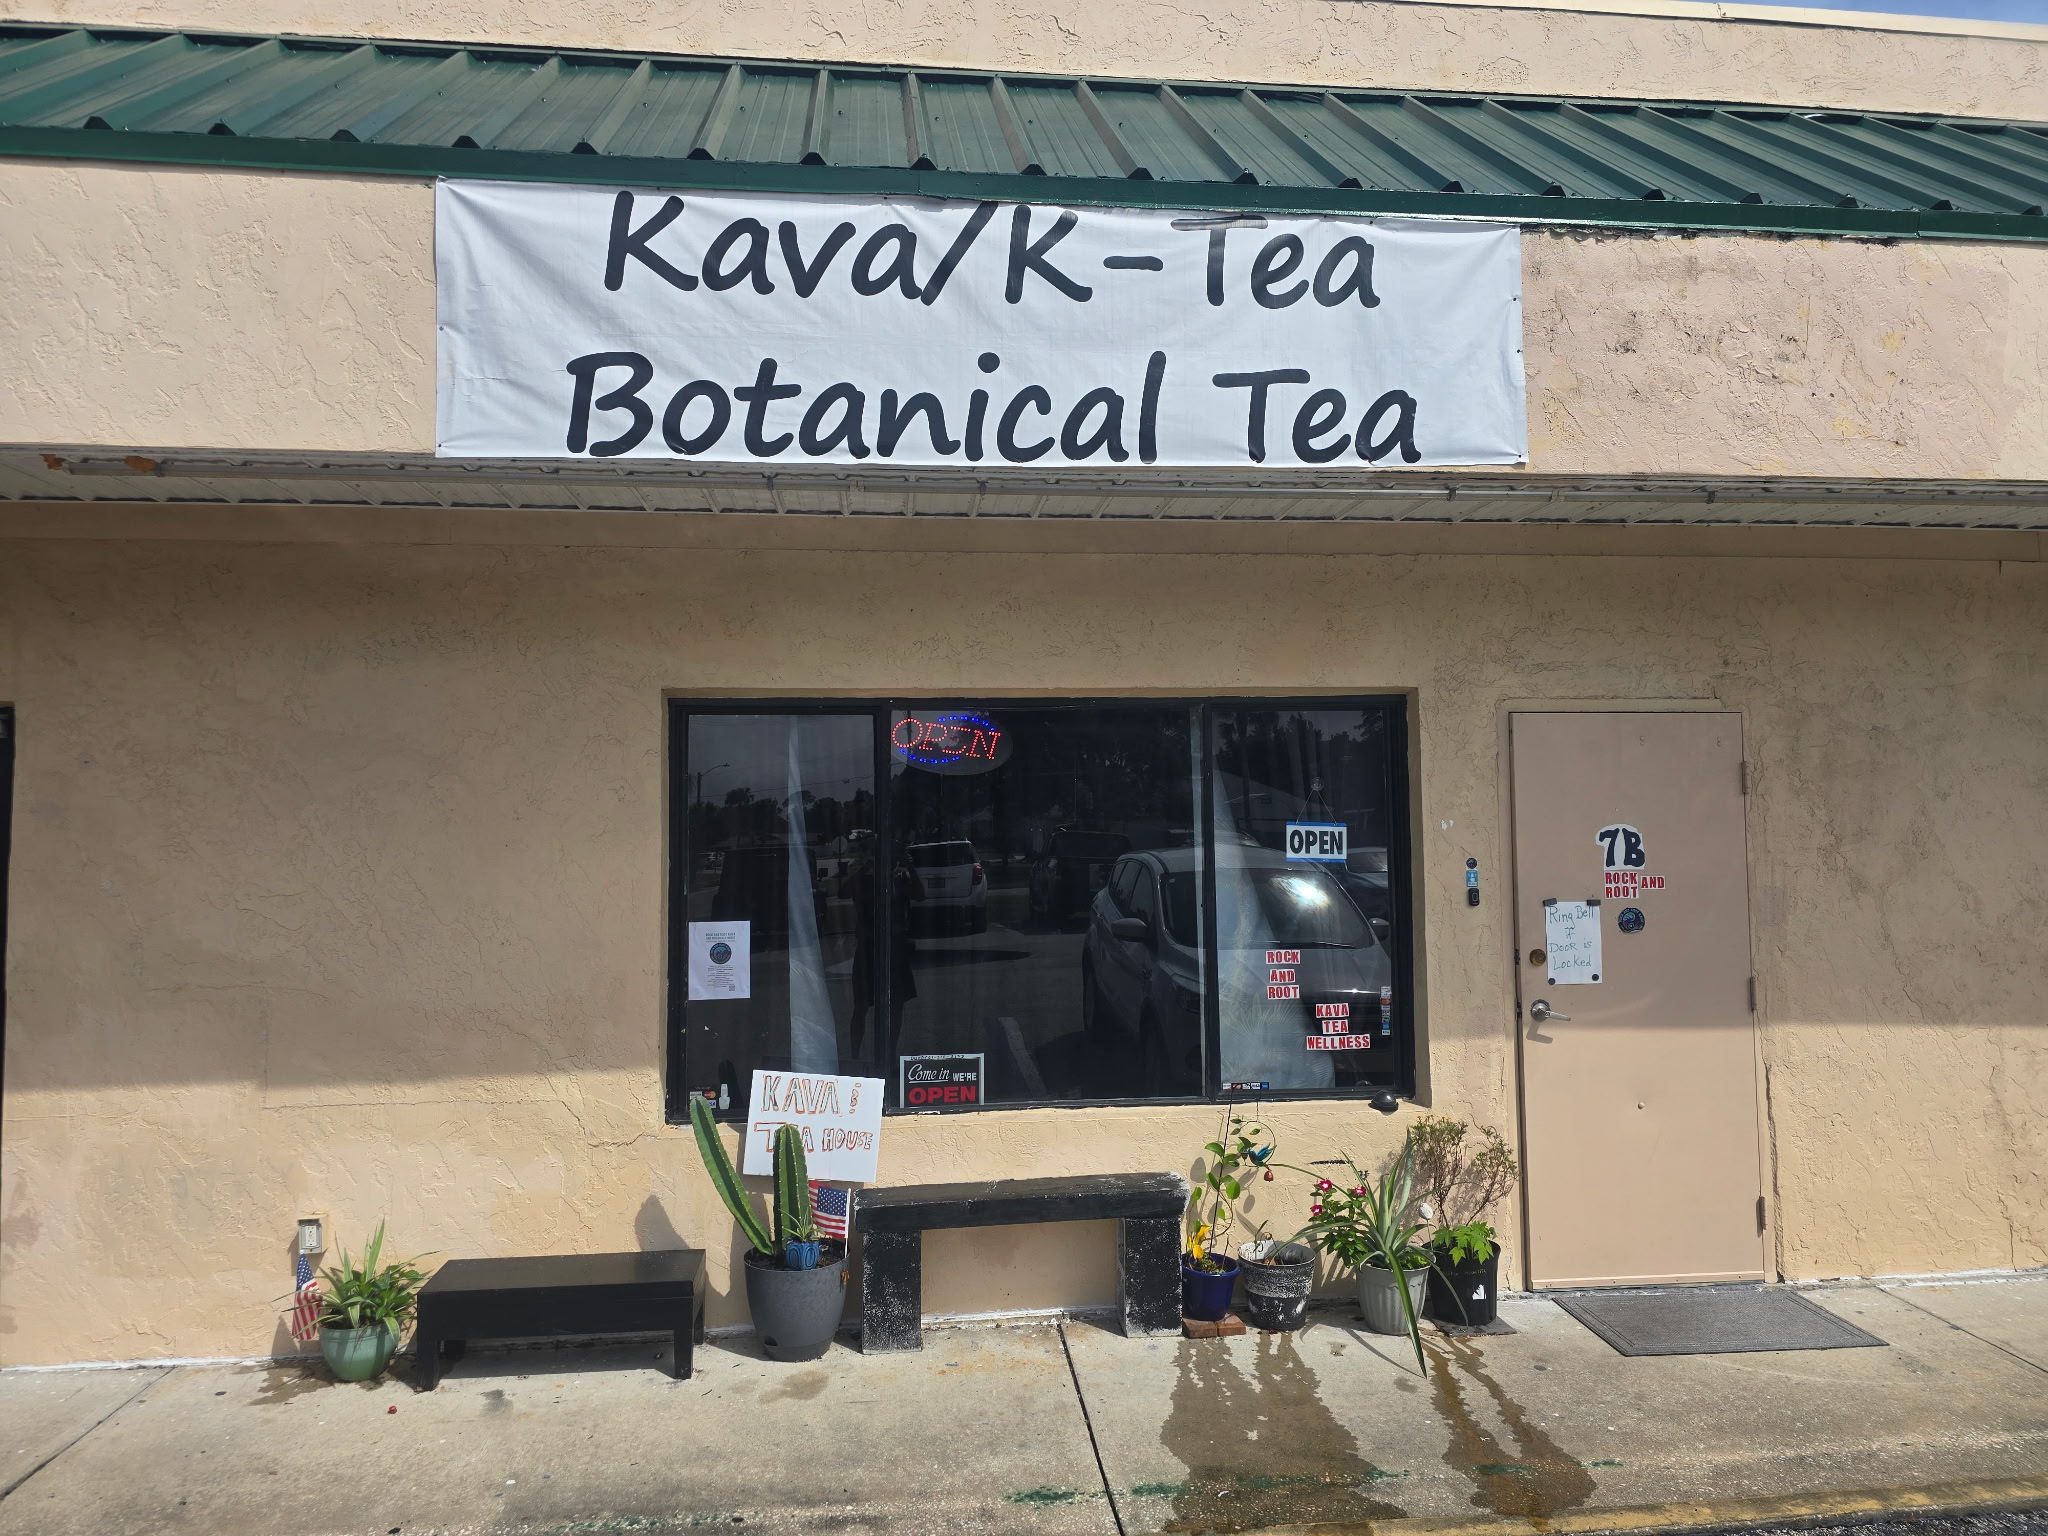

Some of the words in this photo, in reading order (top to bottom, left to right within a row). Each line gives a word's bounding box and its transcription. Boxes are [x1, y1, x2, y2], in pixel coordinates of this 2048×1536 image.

[566, 351, 1167, 464] Botanical
[1212, 368, 1422, 464] Tea
[892, 718, 1001, 760] OPEN
[1289, 829, 1344, 855] OPEN
[1599, 827, 1646, 868] 7B
[1605, 872, 1638, 885] ROCK
[1641, 877, 1665, 888] AND
[1605, 886, 1638, 898] ROOT
[1548, 906, 1576, 929] Ring
[1575, 905, 1594, 919] Bell
[1266, 951, 1300, 963] ROCK
[1553, 954, 1592, 970] Locked
[1270, 970, 1295, 982] AND
[1268, 986, 1299, 999] ROOT
[1316, 1004, 1349, 1017] KAVA
[1323, 1020, 1348, 1033] TEA
[1307, 1035, 1370, 1049] WELLNESS
[908, 1063, 937, 1081] Come
[938, 1068, 950, 1080] in
[953, 1072, 977, 1082] WE'RE
[761, 1074, 840, 1115] KAVA
[908, 1085, 976, 1105] OPEN
[754, 1121, 815, 1153] TA
[822, 1128, 873, 1152] HOUSE
